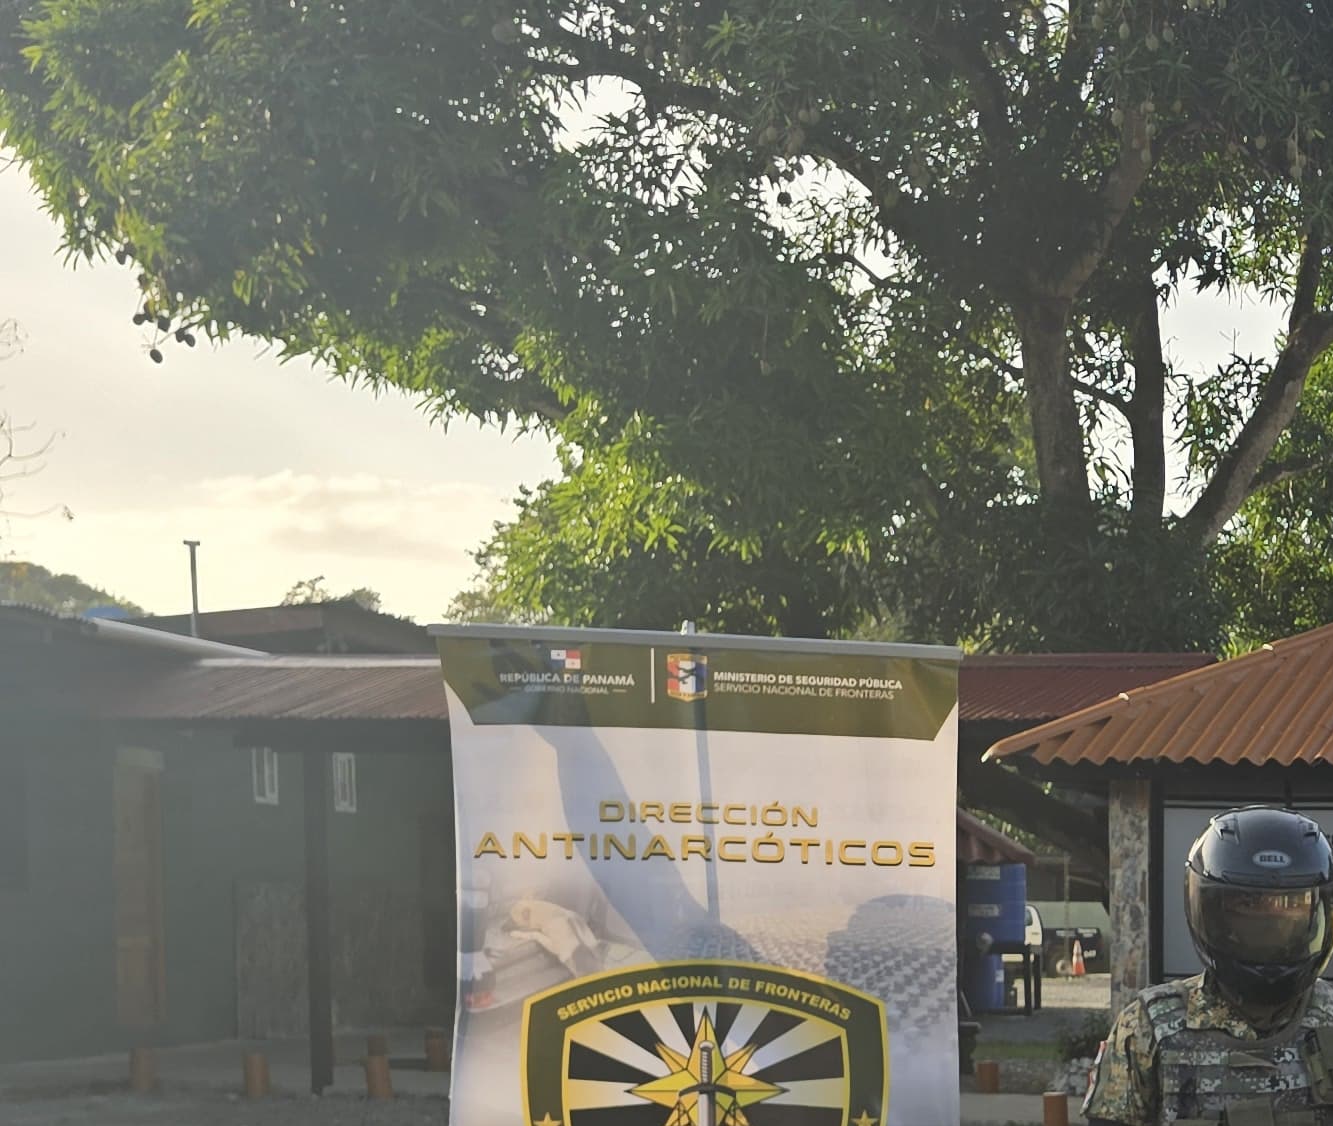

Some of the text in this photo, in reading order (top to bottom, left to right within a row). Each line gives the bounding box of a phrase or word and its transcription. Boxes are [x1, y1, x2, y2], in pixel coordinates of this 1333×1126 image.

[563, 673, 580, 684] DE
[582, 673, 635, 686] PANAMÁ
[714, 671, 902, 689] MINISTERIO DE SEGURIDAD PÚBLICA
[714, 682, 894, 700] SERVICIO NACIONAL DE FRONTERAS
[600, 801, 819, 828] DIRECCIÓN
[473, 831, 937, 867] ANTINARCÓTICOS
[557, 975, 851, 1020] SERVICIO NACIONAL DE FRONTERAS
